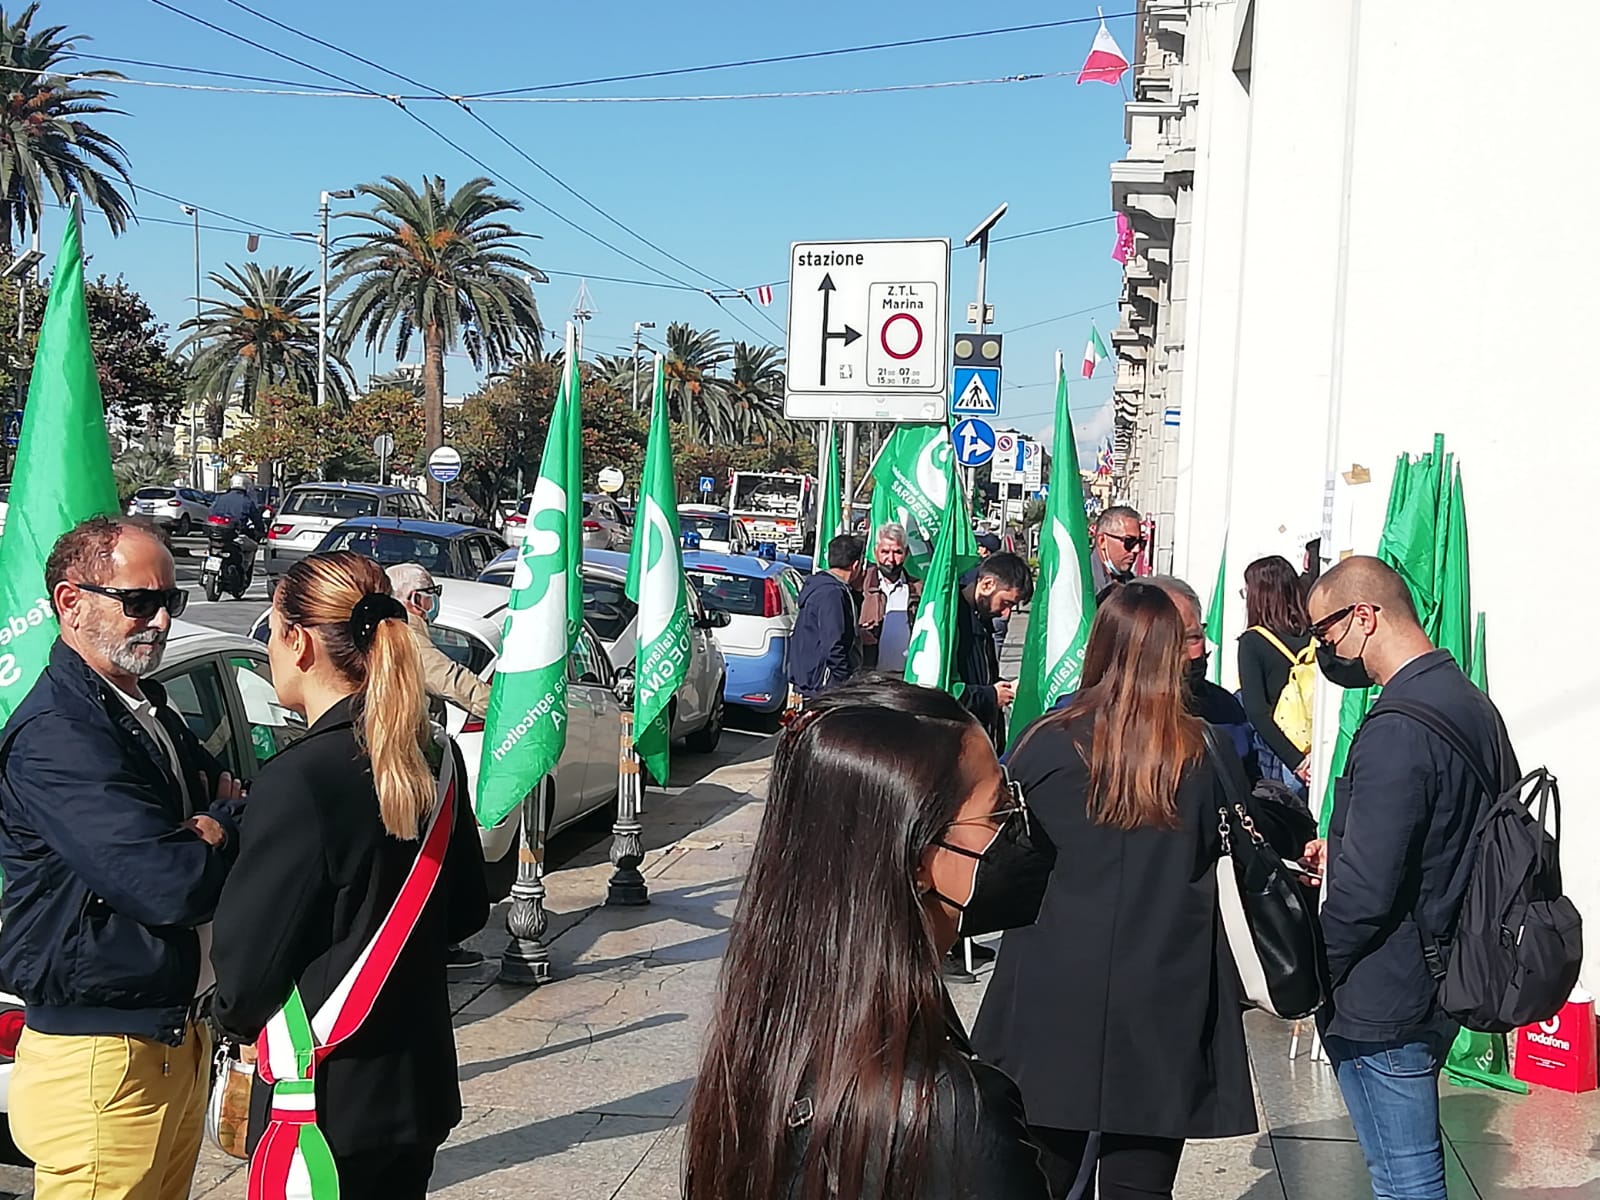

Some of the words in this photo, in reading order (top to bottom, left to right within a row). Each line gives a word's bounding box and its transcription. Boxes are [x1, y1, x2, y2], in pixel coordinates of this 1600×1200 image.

[798, 250, 864, 266] stazione
[888, 285, 919, 296] Z.T.L.
[882, 298, 924, 309] Marina
[892, 480, 940, 537] SARDEGNA
[1526, 1031, 1570, 1051] vodafone
